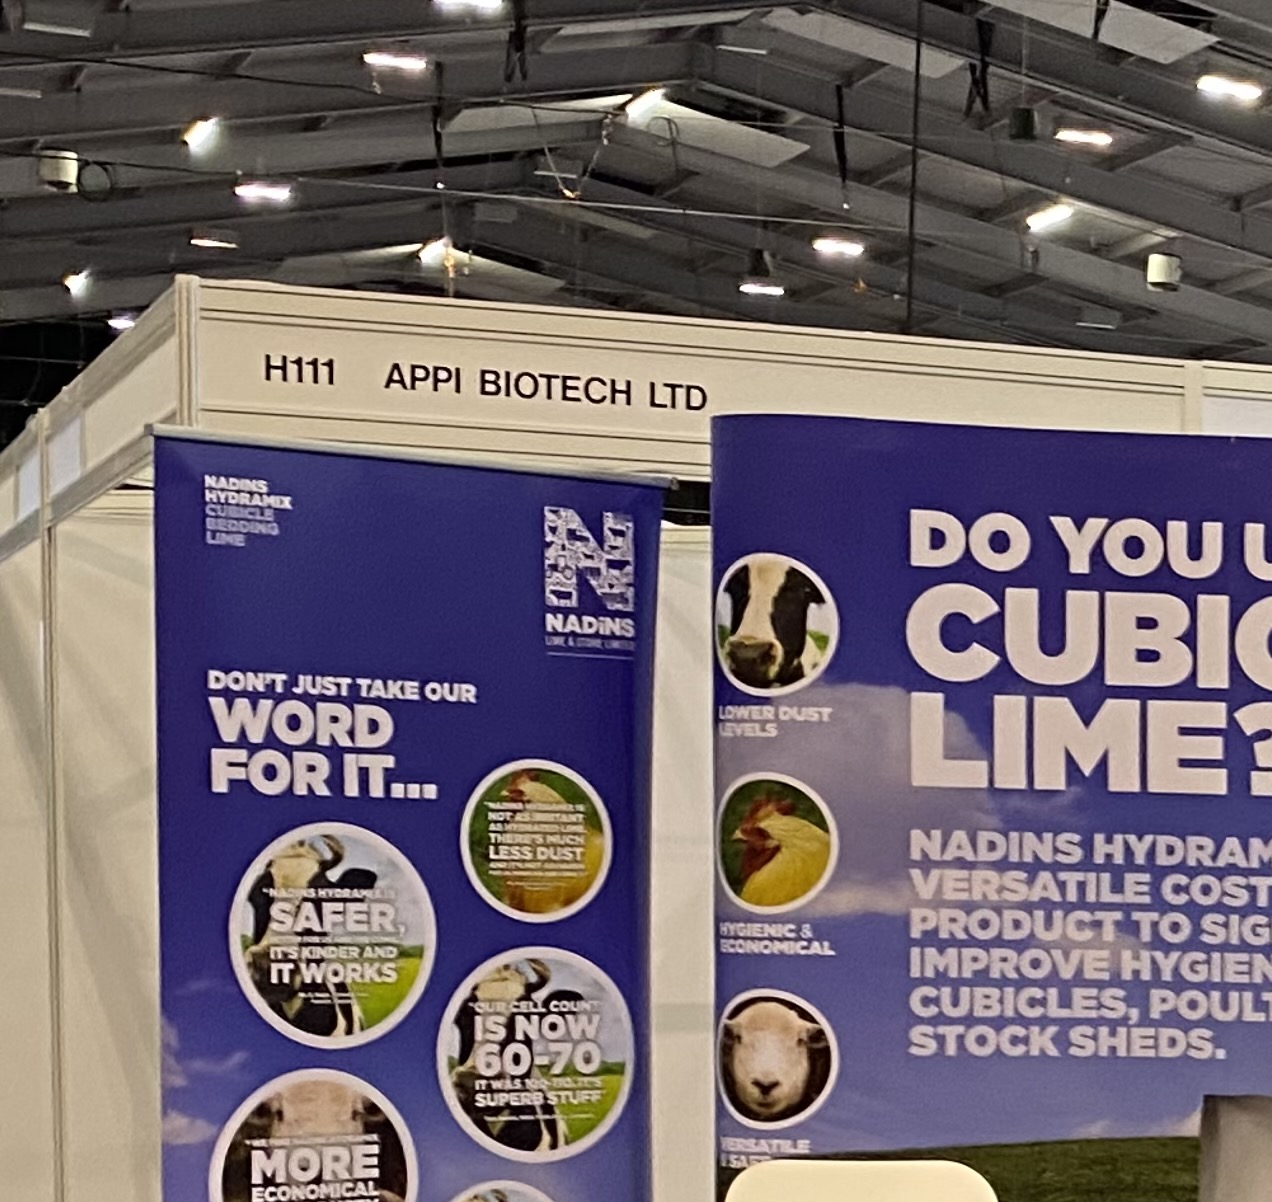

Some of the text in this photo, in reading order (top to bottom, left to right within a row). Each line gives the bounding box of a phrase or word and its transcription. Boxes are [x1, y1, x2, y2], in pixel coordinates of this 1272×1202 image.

[263, 354, 708, 411] H111 APPI BIOTECH LTD
[909, 509, 1031, 573] DO
[1049, 515, 1224, 579] YOU
[208, 669, 477, 703] DON'T JUST TAKE OUR
[208, 696, 394, 749] WORD
[719, 705, 833, 722] LOWER DUST
[719, 723, 778, 737] LEVELS
[210, 747, 439, 800] FOR IT...
[489, 845, 584, 861] LESS DUST
[909, 829, 1083, 864] NADINS
[909, 867, 1152, 904] VERSATILE
[720, 922, 813, 938] HYGIENIC &
[909, 907, 1124, 944] PRODUCT
[1131, 911, 1191, 945] TO
[302, 945, 361, 959] KINDER
[362, 945, 398, 959] AND
[720, 939, 837, 956] ECONOMICAL
[909, 947, 1111, 981] IMPROVE
[269, 962, 398, 984] IT WORKS
[909, 985, 1142, 1025] CUBICLES,
[474, 1013, 600, 1041] IS NOW
[908, 1024, 1228, 1060] STOCK SHEDS.
[474, 1040, 602, 1077] 60-70
[474, 1091, 545, 1107] SUPERB
[251, 1144, 380, 1185] MORE
